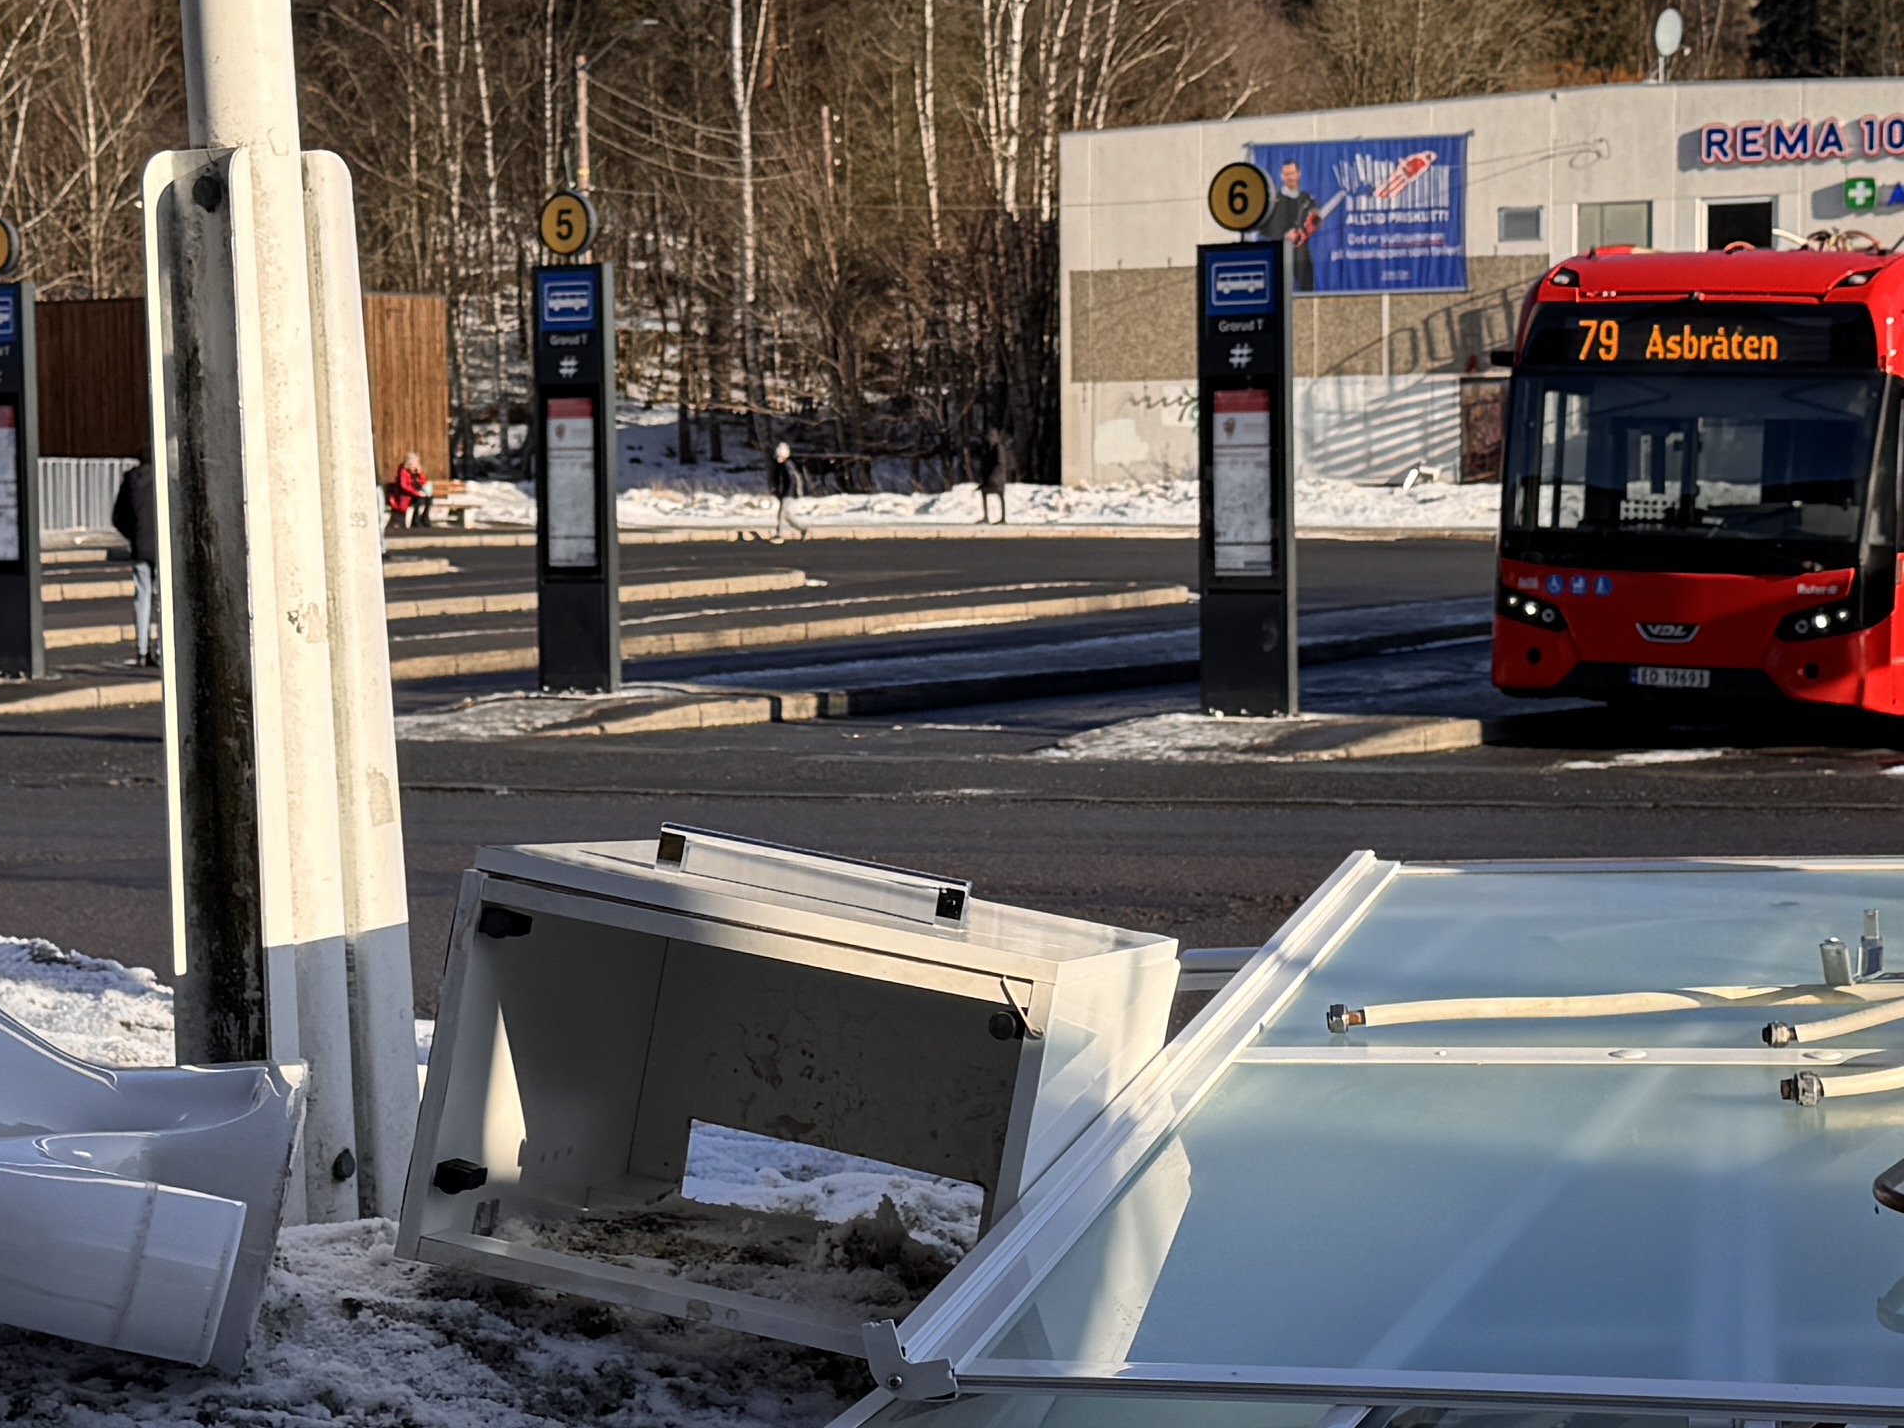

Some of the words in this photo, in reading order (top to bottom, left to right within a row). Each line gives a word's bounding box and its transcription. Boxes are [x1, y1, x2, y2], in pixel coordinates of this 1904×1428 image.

[1702, 118, 1848, 164] REMA
[1227, 180, 1249, 215] 6
[555, 208, 574, 241] 5
[1578, 320, 1620, 361] 79
[1646, 624, 1687, 637] VDL
